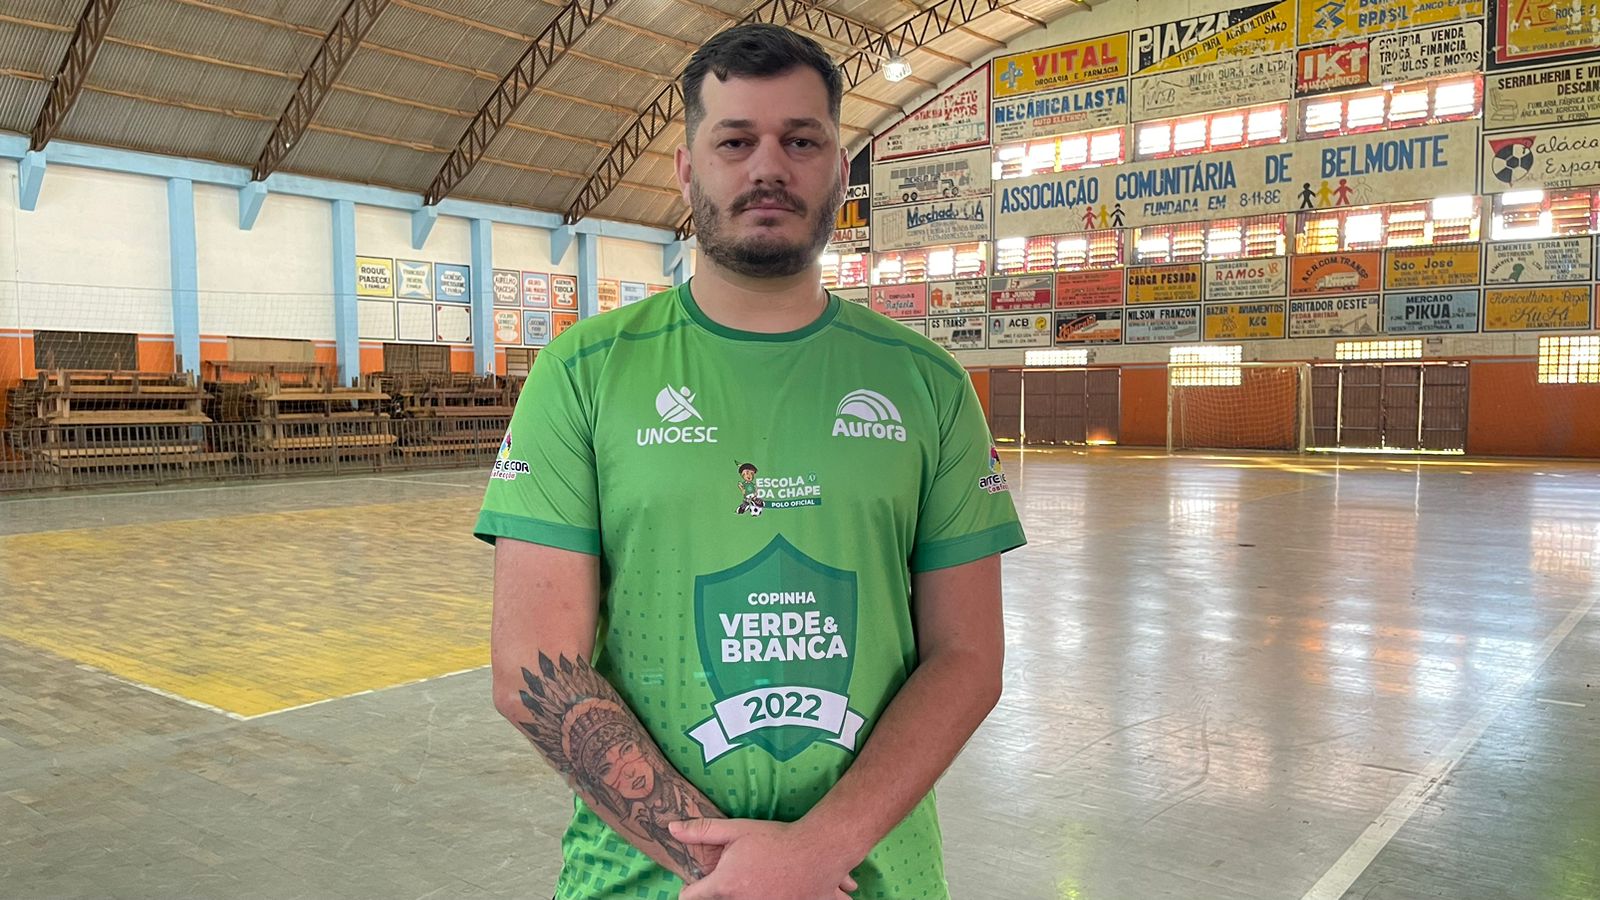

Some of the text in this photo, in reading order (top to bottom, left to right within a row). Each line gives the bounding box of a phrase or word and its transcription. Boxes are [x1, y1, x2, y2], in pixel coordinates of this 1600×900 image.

[1358, 6, 1409, 28] BRASIL
[1555, 5, 1585, 19] ROQE
[1132, 11, 1230, 74] PIAZZA
[1032, 43, 1118, 77] VITAL
[1433, 56, 1441, 68] E
[1498, 69, 1571, 90] SERRALHERIA
[1576, 68, 1583, 80] E
[1557, 80, 1600, 96] DESCAN
[1073, 86, 1126, 111] LASTA
[1000, 134, 1449, 215] ASSOCIAÇÃO COMUNITÁRIA DE BELMONTE
[1143, 197, 1199, 217] FUNDADA
[1207, 195, 1227, 211] EM
[1493, 243, 1532, 252] SEMENTES
[1537, 241, 1560, 249] TERRA
[1424, 256, 1454, 269] José
[361, 266, 386, 276] ROQUE
[1215, 268, 1265, 281] RAMOS
[359, 275, 391, 284] PIASECKI
[1129, 273, 1197, 285] CARGA PESADA
[1291, 298, 1367, 313] BRITADOR OESTE
[1406, 294, 1453, 304] MERCADO
[1128, 308, 1197, 321] NILSON FRANZON
[1206, 304, 1284, 316] BAZAR AVIAMENTOS
[1405, 304, 1451, 320] PIKUA
[1008, 319, 1029, 328] ACB
[637, 426, 718, 446] UNOESC
[832, 418, 907, 442] Aurora
[755, 476, 804, 488] ESCOLA
[756, 485, 821, 498] DA CHAPE
[771, 499, 815, 508] POLO OFICIAL
[748, 592, 816, 605] COPINHA
[719, 611, 838, 637] VERDE &
[721, 635, 849, 663] BRANCA
[743, 691, 822, 724] 2022
